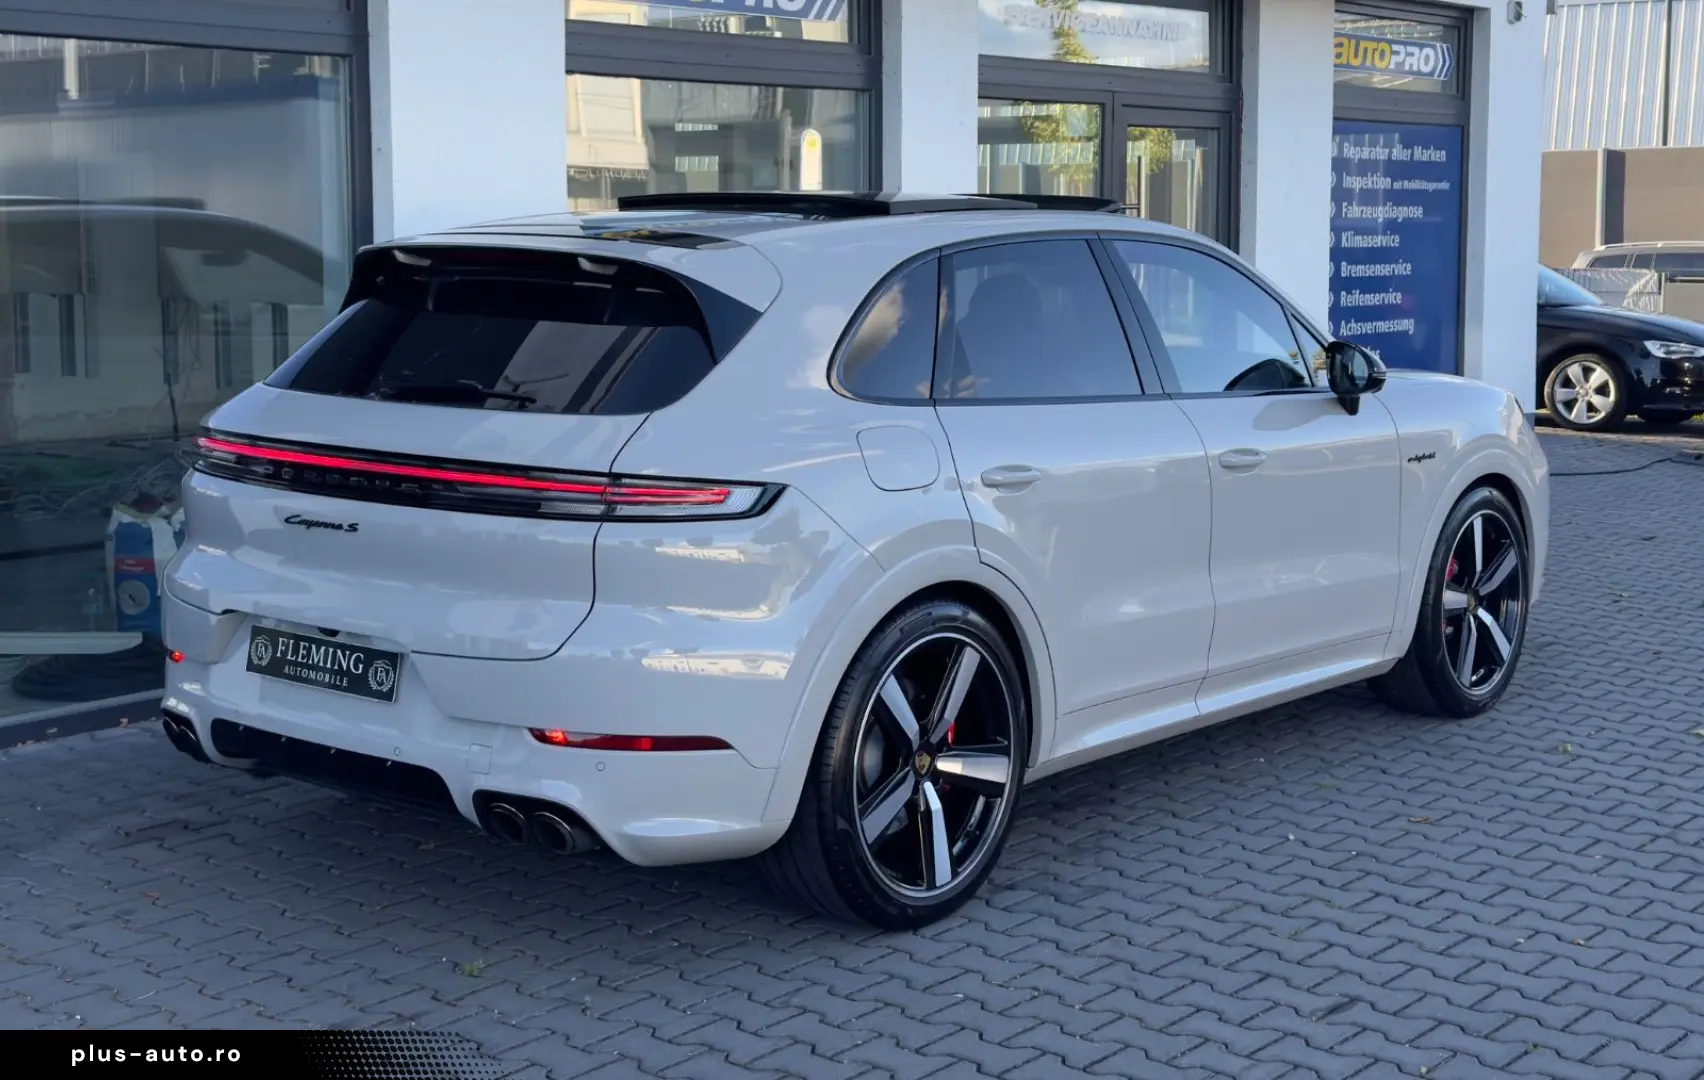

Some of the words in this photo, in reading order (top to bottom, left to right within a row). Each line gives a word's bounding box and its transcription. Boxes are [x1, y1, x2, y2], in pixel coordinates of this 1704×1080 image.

[1343, 142, 1390, 163] Reparatur
[1391, 143, 1412, 161] aller
[1413, 145, 1447, 162] Marken
[1342, 172, 1392, 193] Inspektion
[1342, 201, 1424, 222] Fahrzeugdiagnose
[1341, 231, 1401, 248] Klimaservice
[1340, 259, 1412, 277] Bremsenservice
[1340, 288, 1403, 307] Reifenservice
[1339, 318, 1415, 336] Achsvermessung
[343, 522, 360, 533] S
[276, 637, 365, 674] FLEMING
[284, 665, 349, 687] AUTOMOBILE
